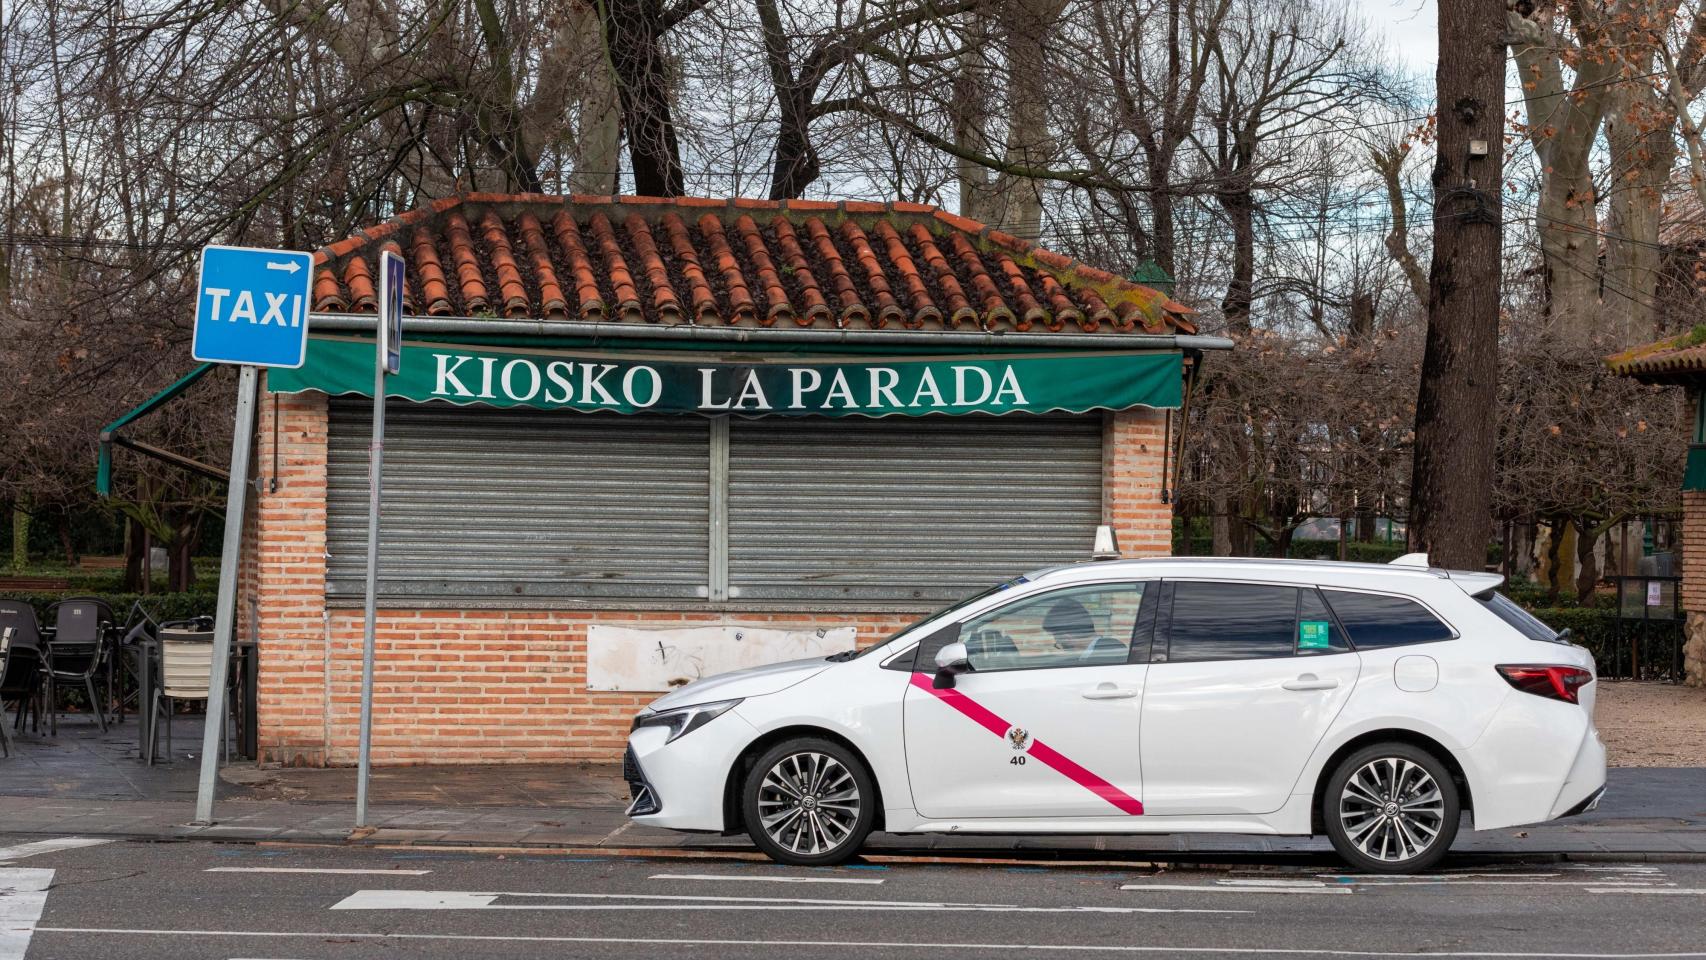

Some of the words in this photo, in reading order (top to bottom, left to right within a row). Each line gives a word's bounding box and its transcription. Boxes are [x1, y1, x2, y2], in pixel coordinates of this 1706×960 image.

[205, 287, 302, 328] TAXI
[431, 353, 663, 408] KIOSKO
[697, 368, 773, 410] LA
[787, 364, 1029, 409] PARADA
[1010, 755, 1026, 766] 40
